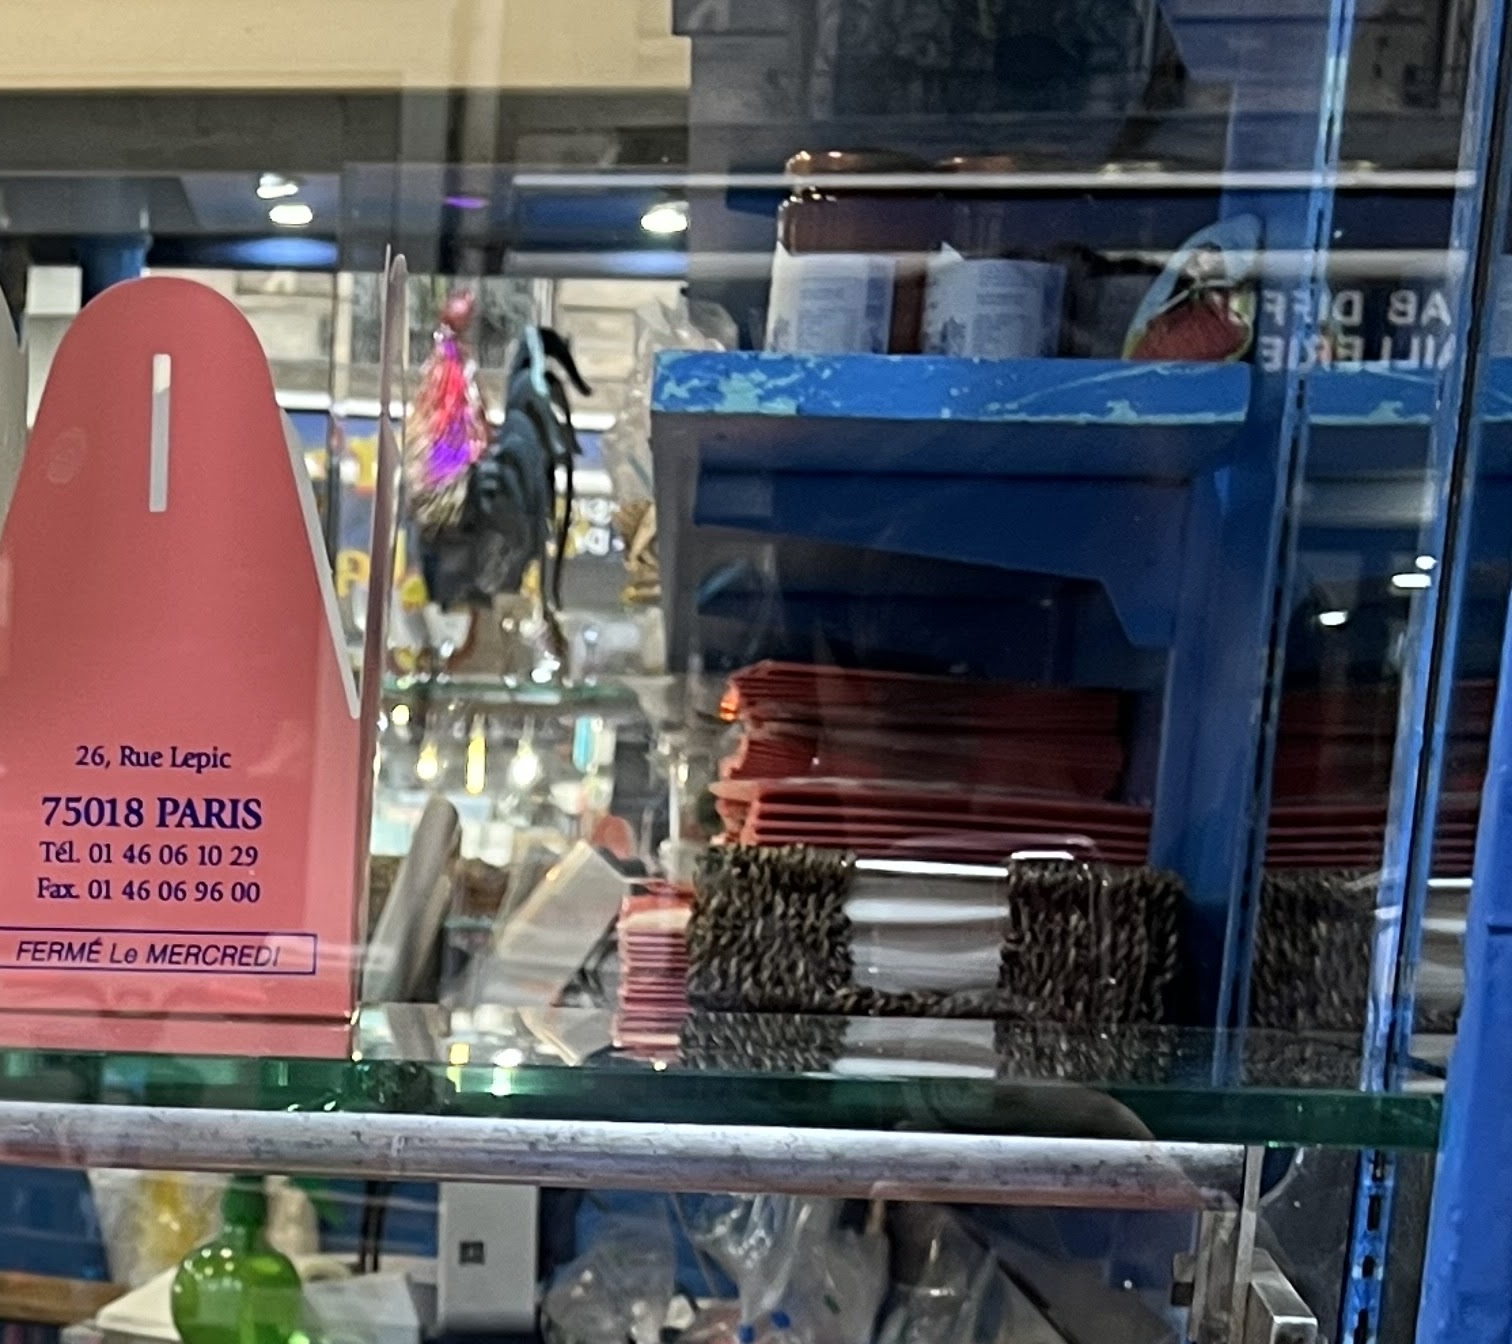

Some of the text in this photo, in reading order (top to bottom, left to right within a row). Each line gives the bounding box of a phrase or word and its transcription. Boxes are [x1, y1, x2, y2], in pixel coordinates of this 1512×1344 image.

[74, 745, 233, 774] 26, Rue Lepic
[41, 796, 263, 831] 75018 PARIS
[39, 840, 259, 868] Tél. 01 46 06 10 29
[87, 879, 112, 900] 01
[121, 879, 152, 901] 46
[158, 880, 188, 902] 06
[193, 880, 224, 903] 96
[230, 881, 261, 903] 00
[15, 937, 281, 968] FERMÉ Le MERCREDI
